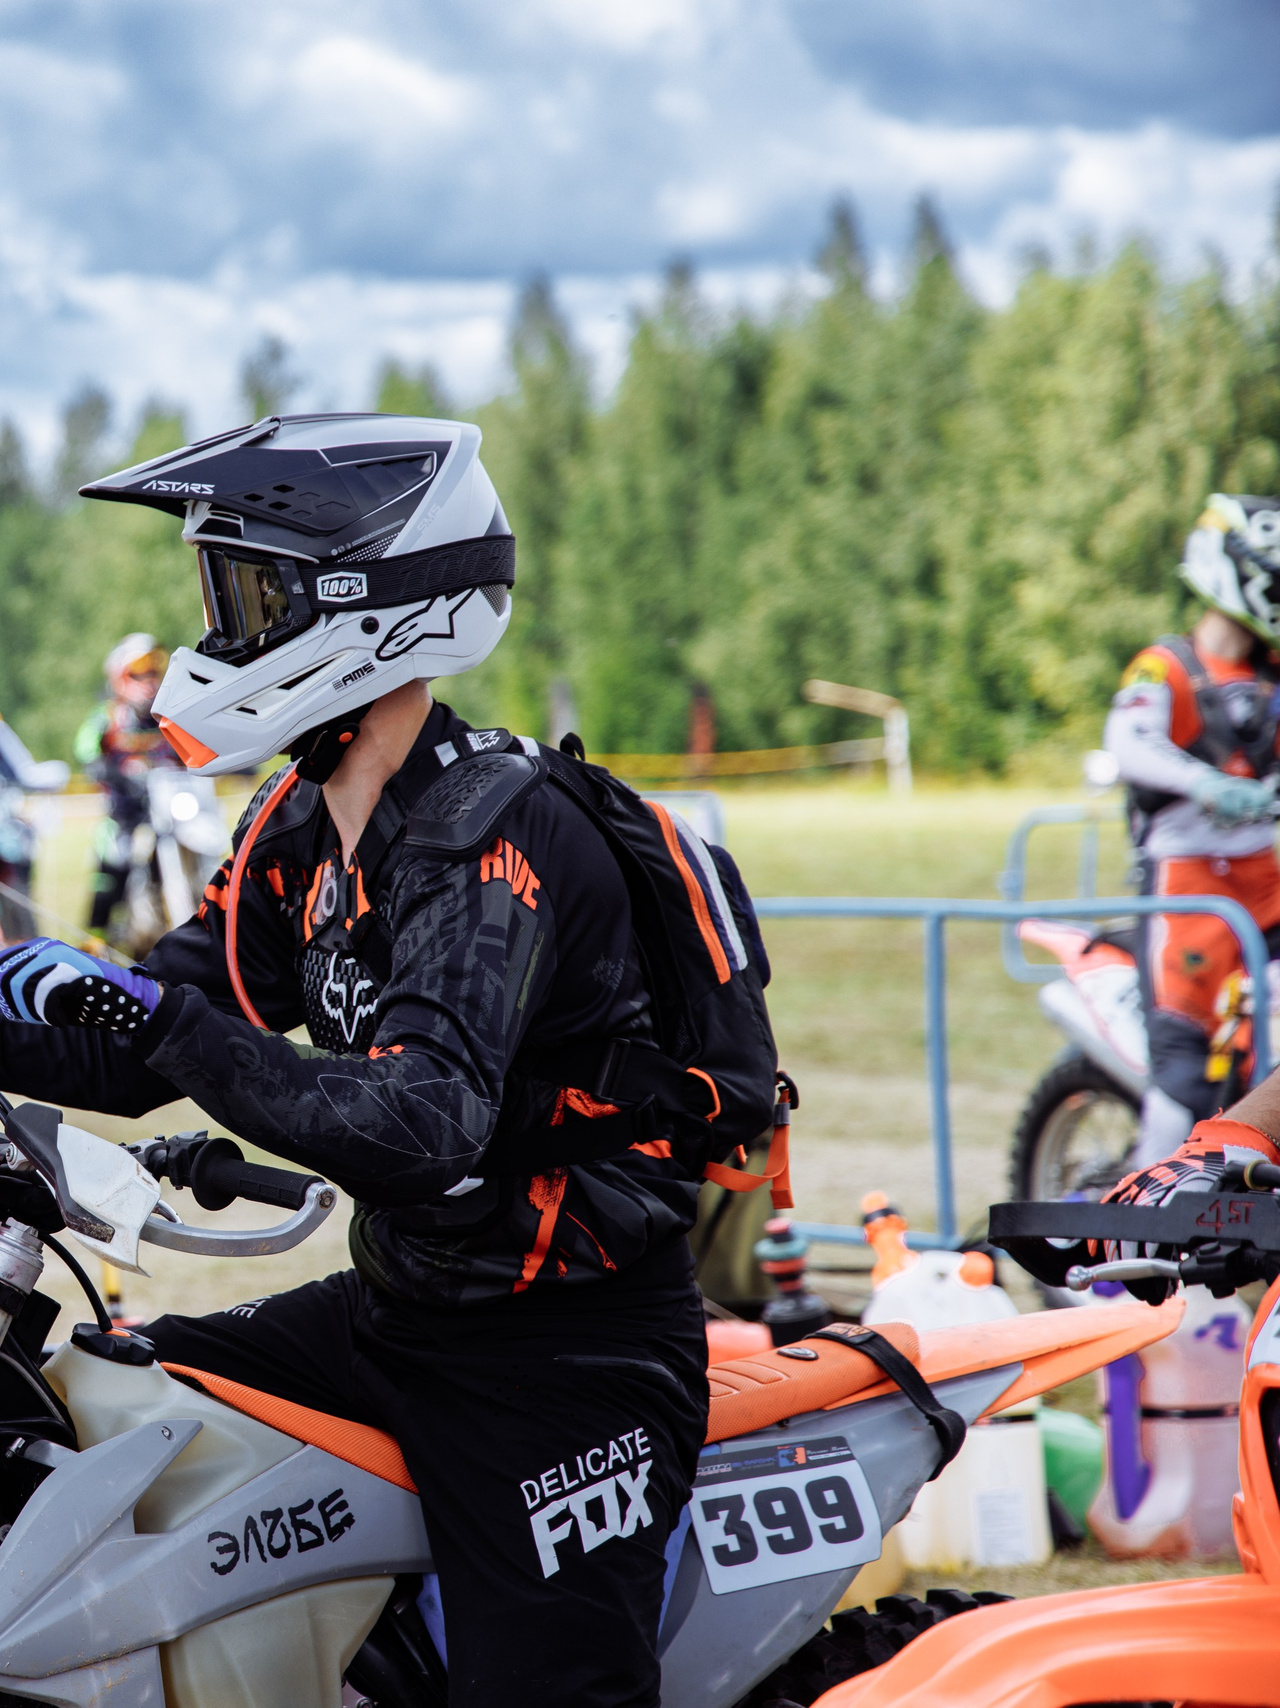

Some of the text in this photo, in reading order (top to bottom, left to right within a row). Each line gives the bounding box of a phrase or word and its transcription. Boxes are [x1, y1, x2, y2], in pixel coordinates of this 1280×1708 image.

[142, 480, 215, 495] ASTARS
[321, 577, 362, 596] 100%
[520, 1427, 651, 1510] DELICATE
[529, 1459, 654, 1579] FOX
[701, 1475, 865, 1567] 399
